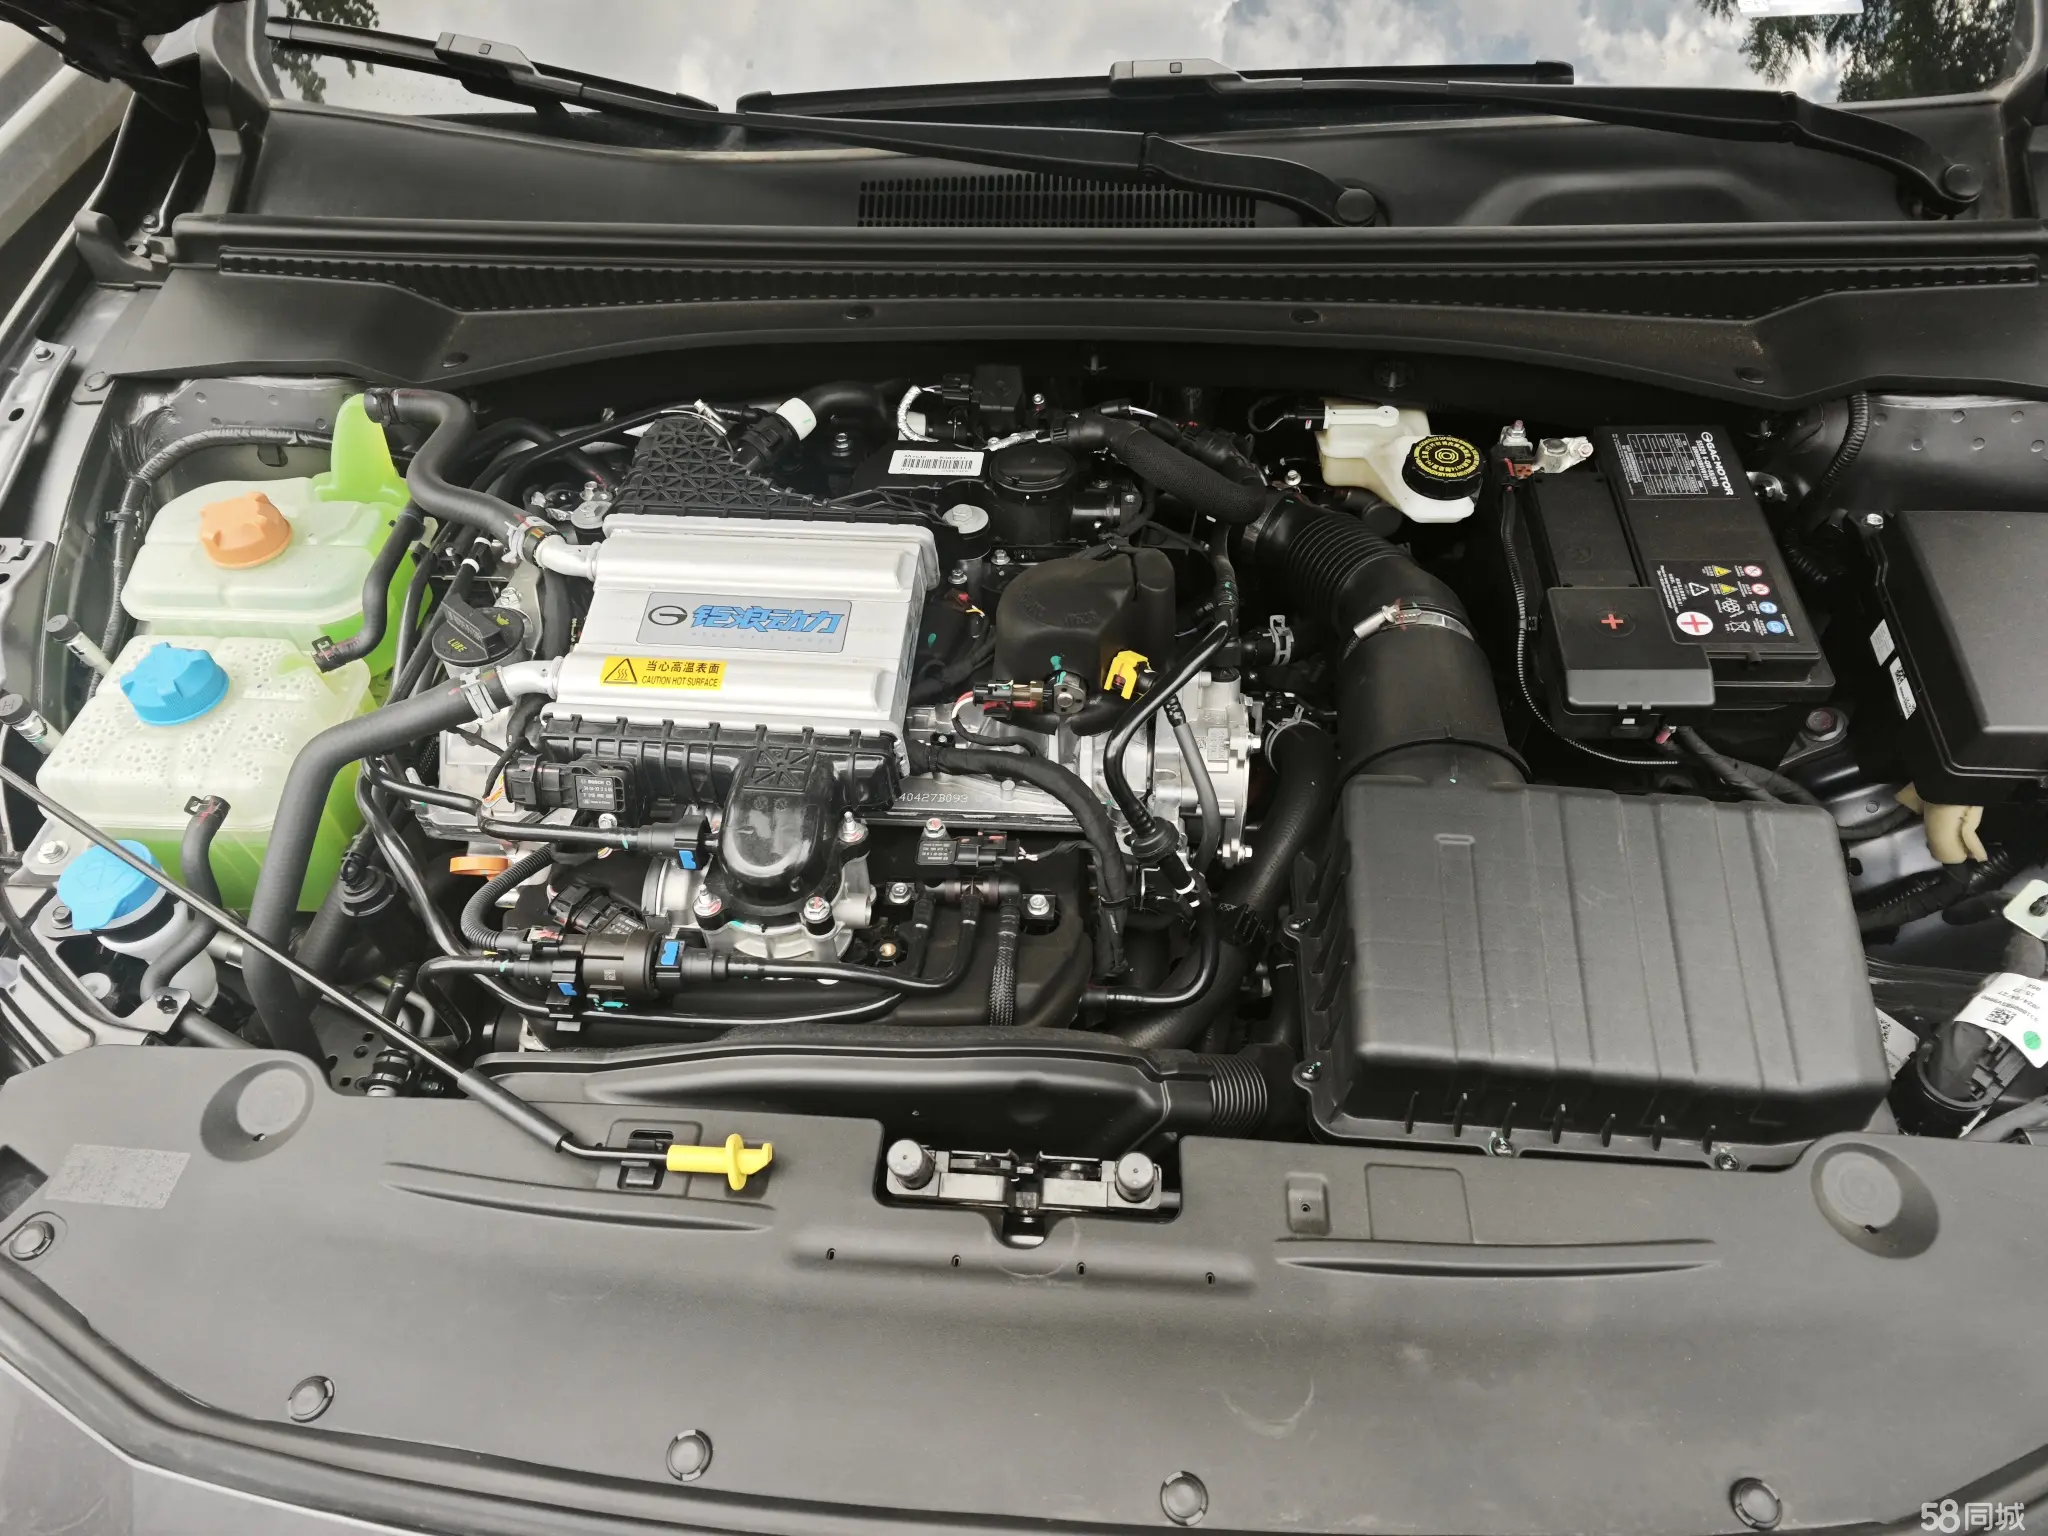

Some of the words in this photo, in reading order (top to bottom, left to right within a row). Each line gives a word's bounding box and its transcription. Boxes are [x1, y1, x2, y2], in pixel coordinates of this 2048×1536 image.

[1706, 442, 1721, 461] GAC
[1713, 460, 1734, 496] MOTOR
[692, 604, 844, 633] 钜浪动力
[447, 638, 468, 653] LUBE
[646, 660, 721, 675] 当心高温表面
[641, 675, 671, 686] CAUTION
[672, 676, 686, 686] HOT
[687, 676, 718, 687] SURFACE
